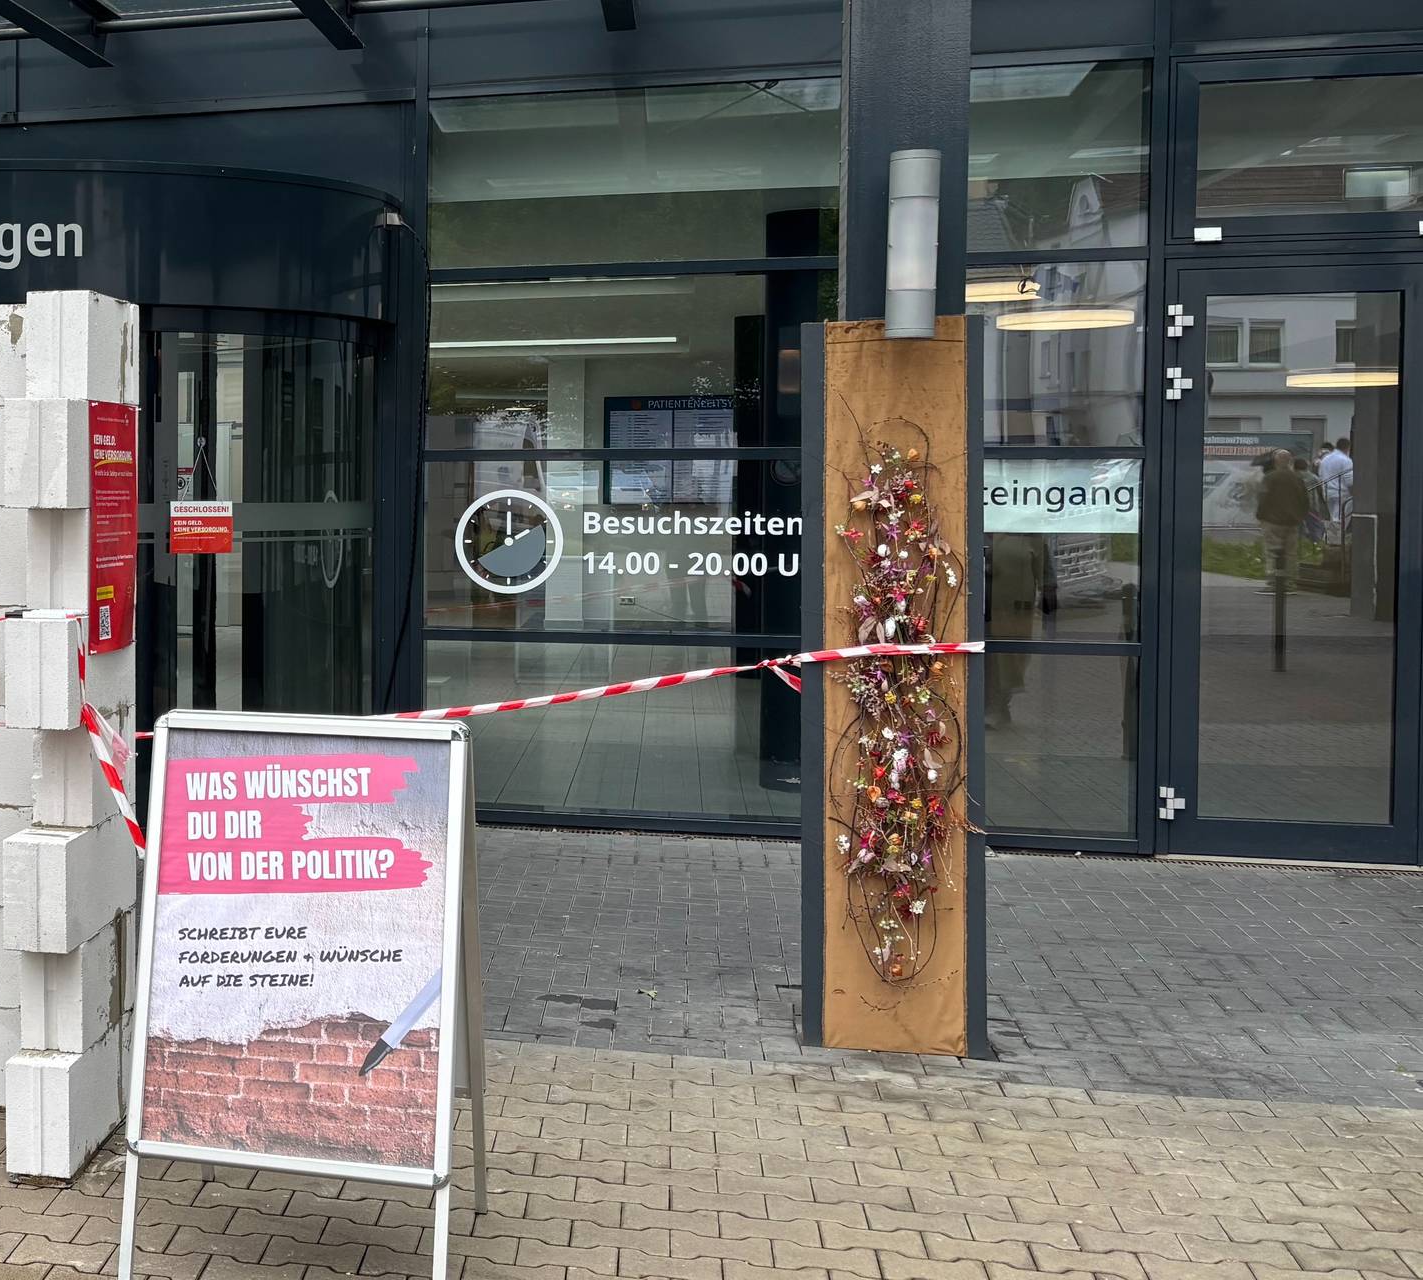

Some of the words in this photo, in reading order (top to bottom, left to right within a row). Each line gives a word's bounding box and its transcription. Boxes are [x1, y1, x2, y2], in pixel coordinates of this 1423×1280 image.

[173, 505, 230, 513] GESCHLOSSEN!
[583, 510, 803, 536] Besuchszeiten
[583, 551, 660, 575] 14.00
[687, 552, 768, 576] 20.00
[186, 772, 237, 800] WAS
[244, 764, 371, 800] WÜNSCHST
[187, 811, 217, 840] DU
[224, 810, 262, 839] DIR
[187, 851, 233, 882] VON
[240, 850, 284, 881] DER
[291, 848, 395, 880] POLITIK?
[178, 927, 261, 940] SCHREIBT
[264, 926, 308, 940] EURE
[178, 949, 297, 964] FORDERUNGEN
[303, 953, 314, 963] +
[319, 946, 403, 963] WÜNSCHE
[179, 974, 211, 988] AUF
[216, 974, 243, 987] DIE
[249, 973, 314, 988] STEINE!
